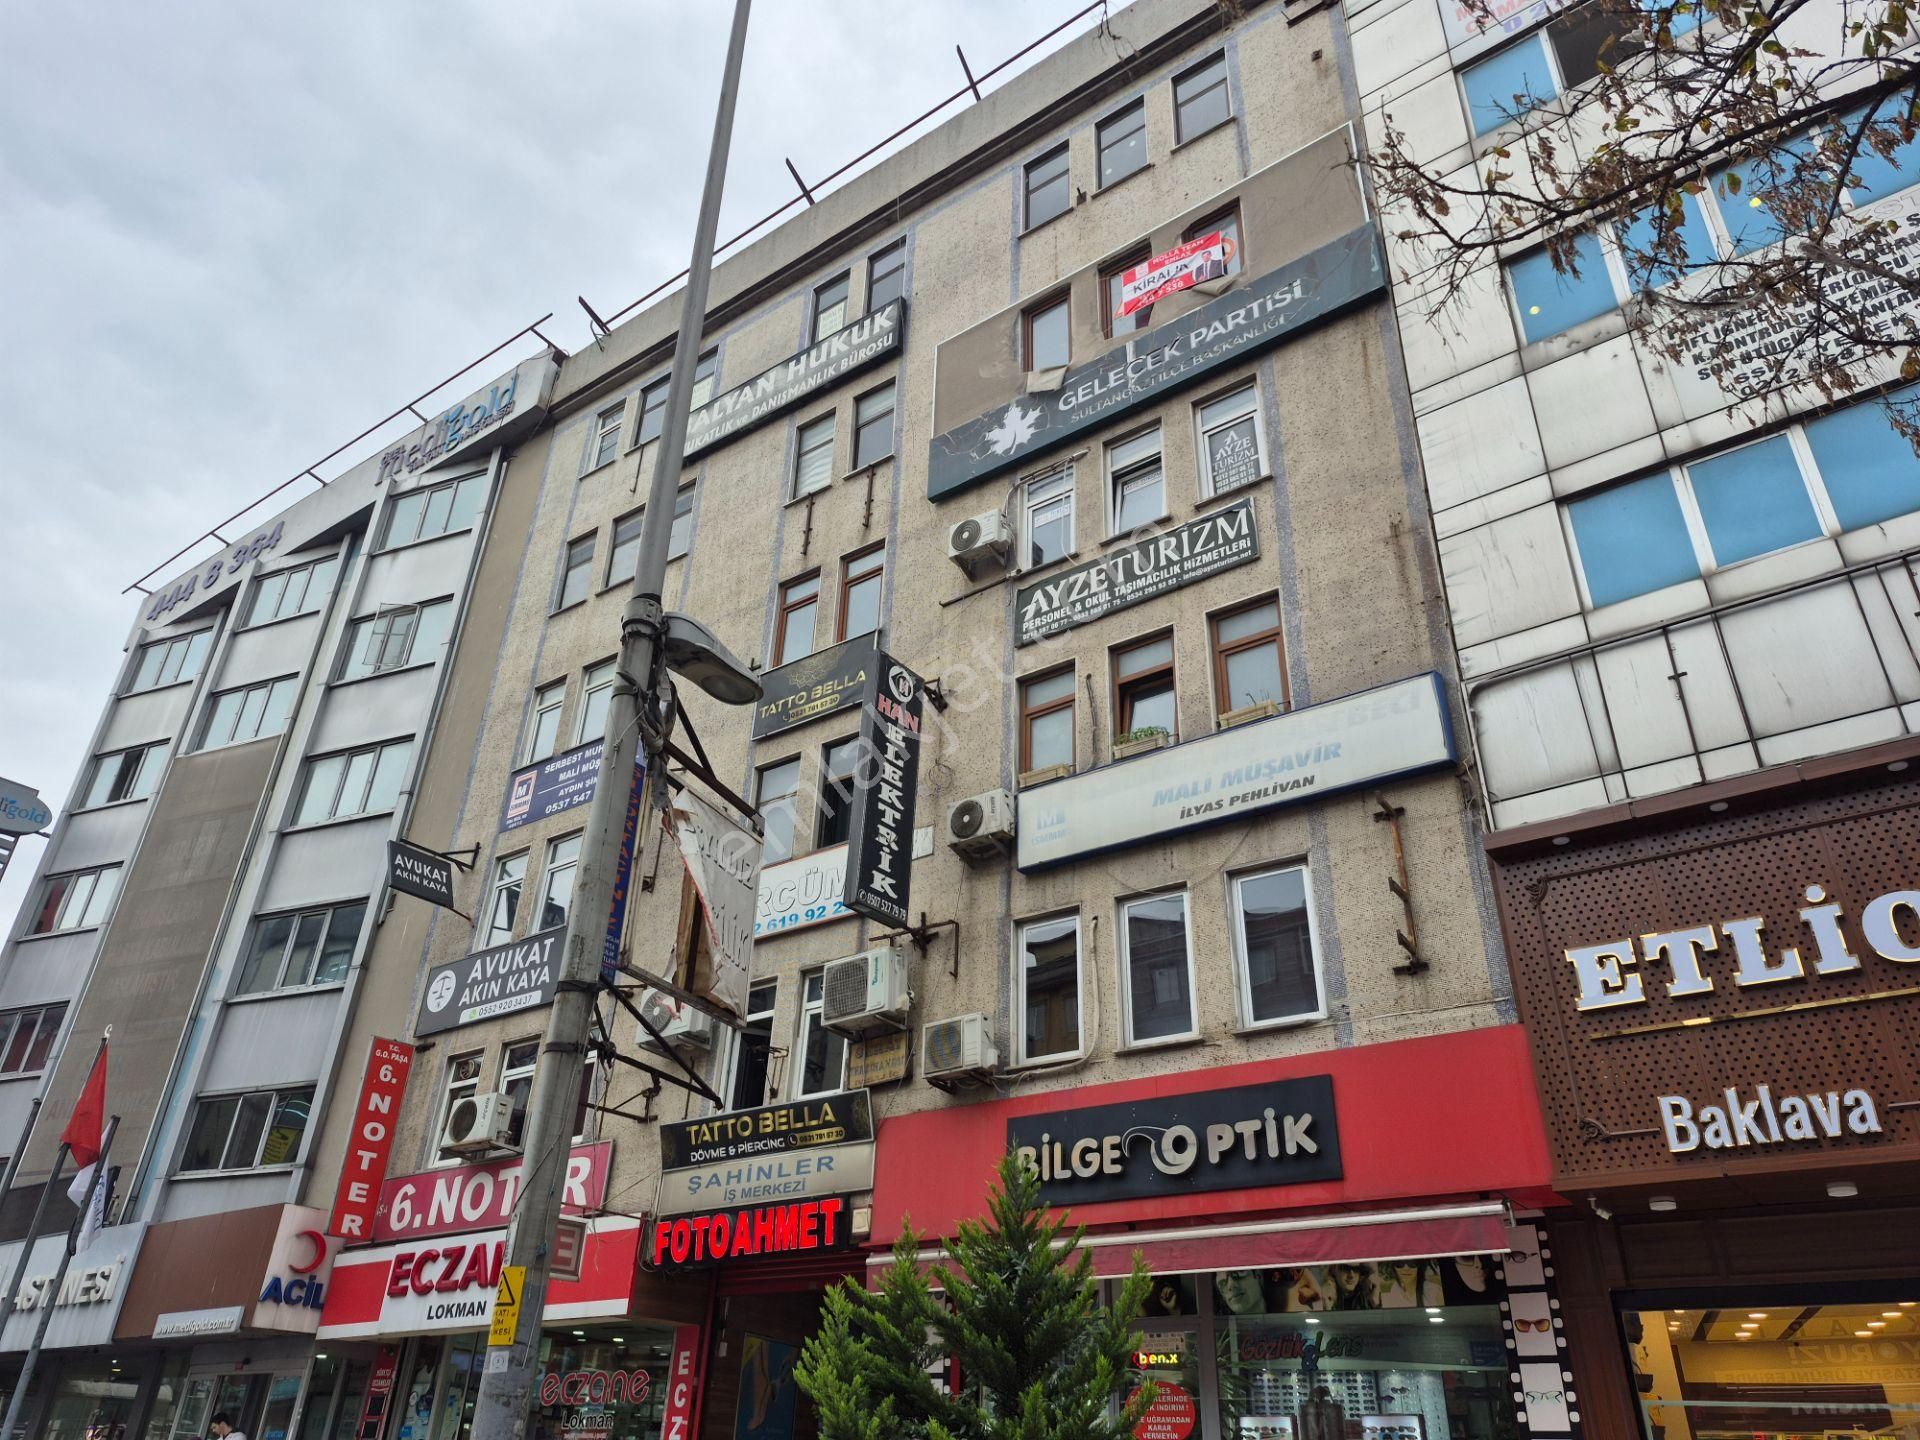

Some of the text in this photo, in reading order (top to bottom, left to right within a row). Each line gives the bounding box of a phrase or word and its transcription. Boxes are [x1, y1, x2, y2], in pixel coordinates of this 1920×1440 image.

[787, 304, 894, 382] HUKUK
[840, 332, 893, 371] BÜROSU
[1058, 278, 1302, 411] GELECEK PARTİSİ
[1214, 435, 1252, 461] AYZE
[147, 520, 286, 621] 444 8 364
[1022, 606, 1072, 633] PERSONEL
[1085, 591, 1112, 608] OKUL
[1114, 563, 1181, 597] TAŞIMACILIK
[1183, 537, 1251, 571] HİZMETLERİ
[759, 669, 866, 719] TATTO BELLA
[878, 692, 920, 735] HAN
[544, 751, 583, 774] SERBEST
[559, 766, 579, 782] MALİ
[1220, 741, 1342, 789] MÜŞAVİR
[544, 799, 570, 814] 0537
[572, 790, 592, 805] 547
[558, 783, 583, 797] AYDIN
[1179, 774, 1316, 821] İLYAS PEHLİVAN
[868, 721, 908, 900] ELEKTRİK
[394, 853, 448, 884] AVUKAT
[396, 868, 448, 894] AKIN KAYA
[767, 913, 799, 930] 619
[805, 905, 827, 921] 92
[466, 937, 555, 984] AVUKAT
[458, 965, 550, 1007] AKIN KAYA
[379, 1064, 398, 1084] 6.
[686, 1102, 837, 1146] TATTO BELLA
[1657, 1083, 1883, 1154] Baklava
[340, 1092, 393, 1237] NOTER
[690, 1146, 727, 1162] DÖVME
[728, 1145, 736, 1156] &
[737, 1137, 785, 1155] PİERCİNG
[1017, 1132, 1122, 1184] BİLGE
[389, 1157, 592, 1232] 6.NOTR
[687, 1155, 835, 1195] ŞAHİNLER
[723, 1177, 806, 1203] İŞ MERKEZİ
[260, 1275, 324, 1310] ACİL
[427, 1300, 488, 1321] LOKMAN
[540, 1369, 650, 1407] eczane
[561, 1410, 615, 1430] Lokman
[1146, 1414, 1191, 1424] UĞRAMADAN
[1147, 1423, 1173, 1432] KARAR
